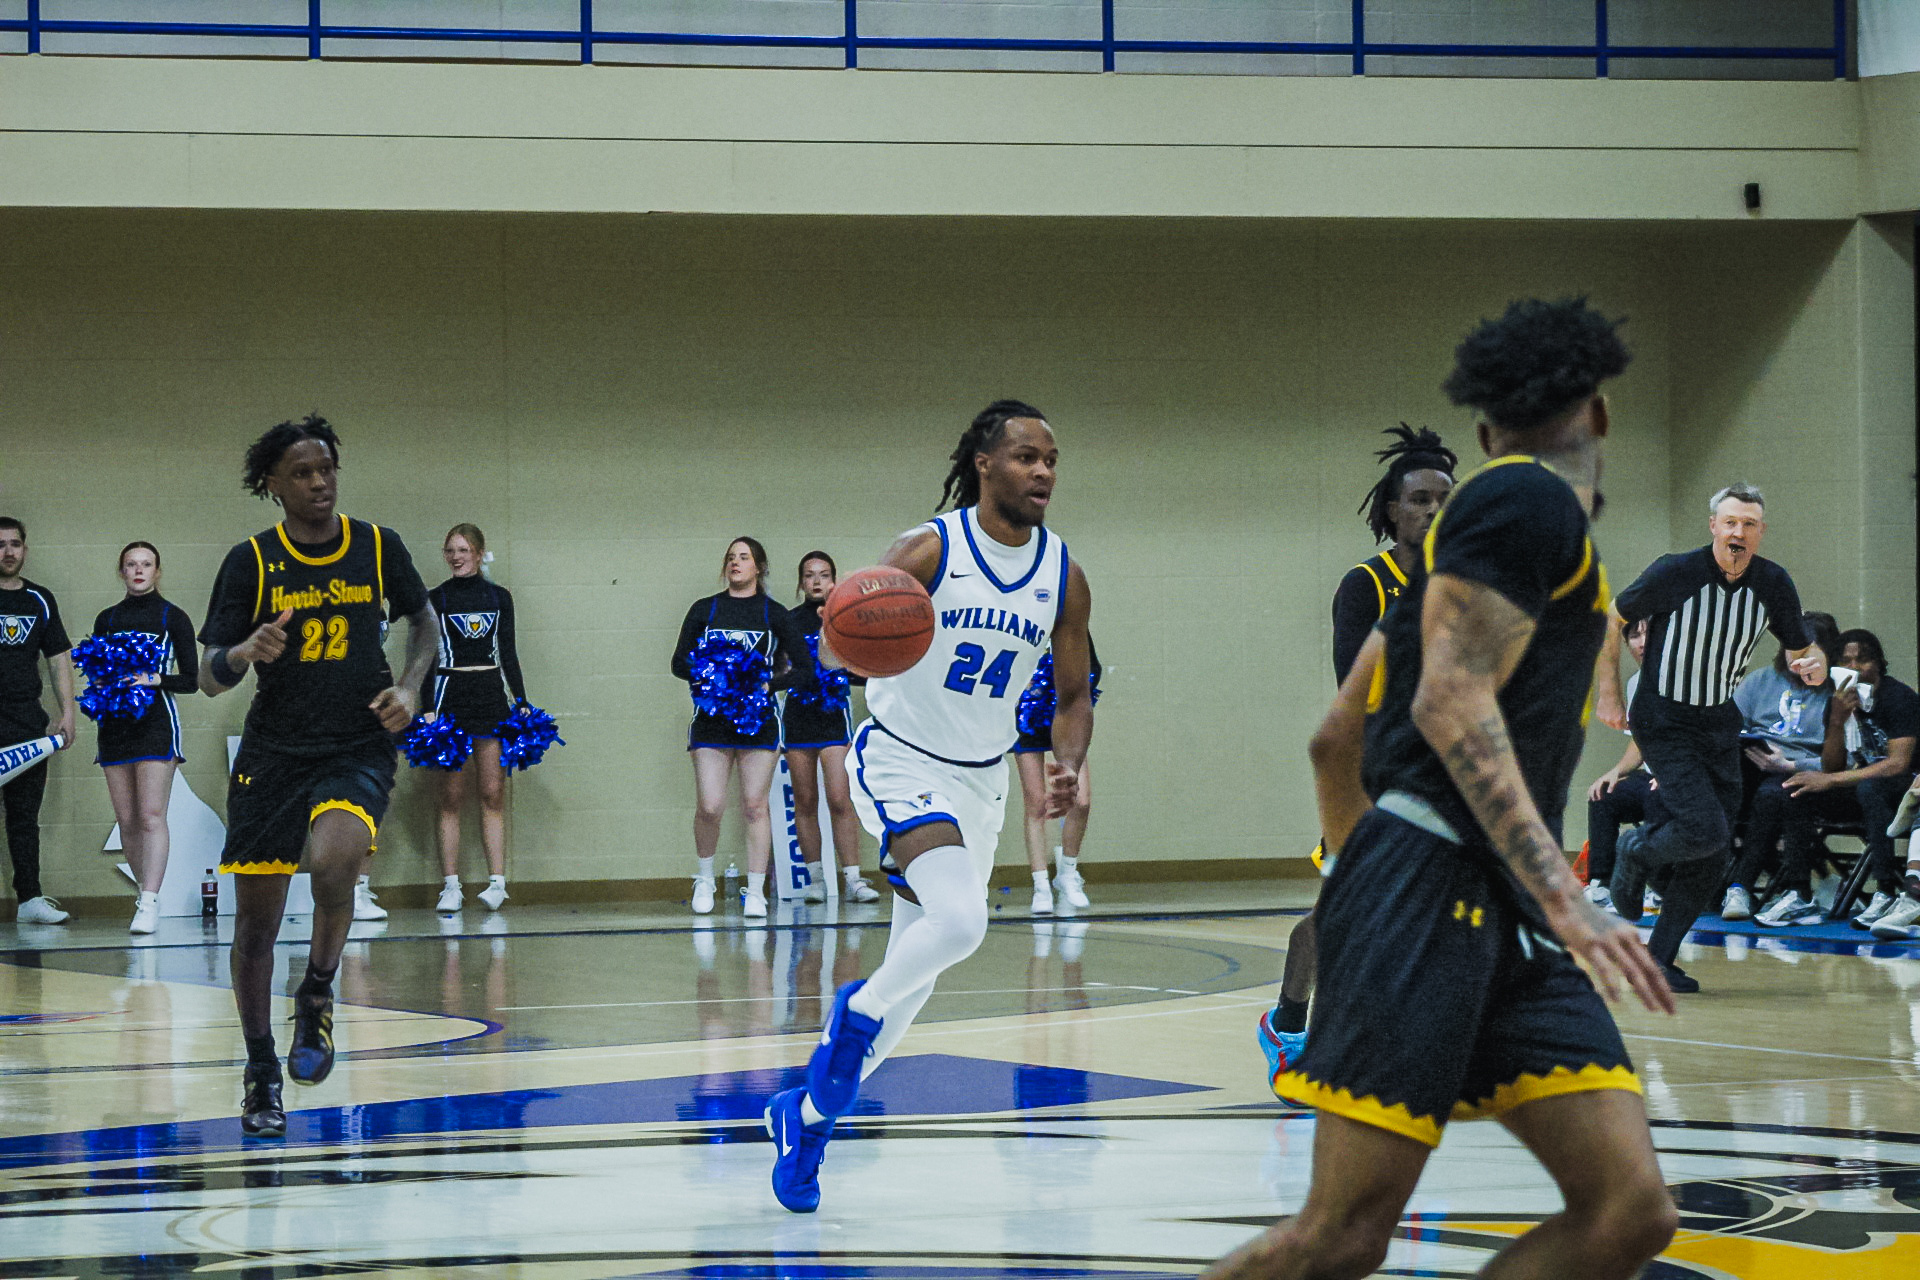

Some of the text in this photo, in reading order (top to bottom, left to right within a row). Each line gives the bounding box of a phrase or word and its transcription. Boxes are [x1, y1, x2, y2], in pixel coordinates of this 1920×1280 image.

[271, 579, 372, 613] Harris-Stowe
[300, 615, 349, 662] 22
[943, 641, 1019, 698] 24
